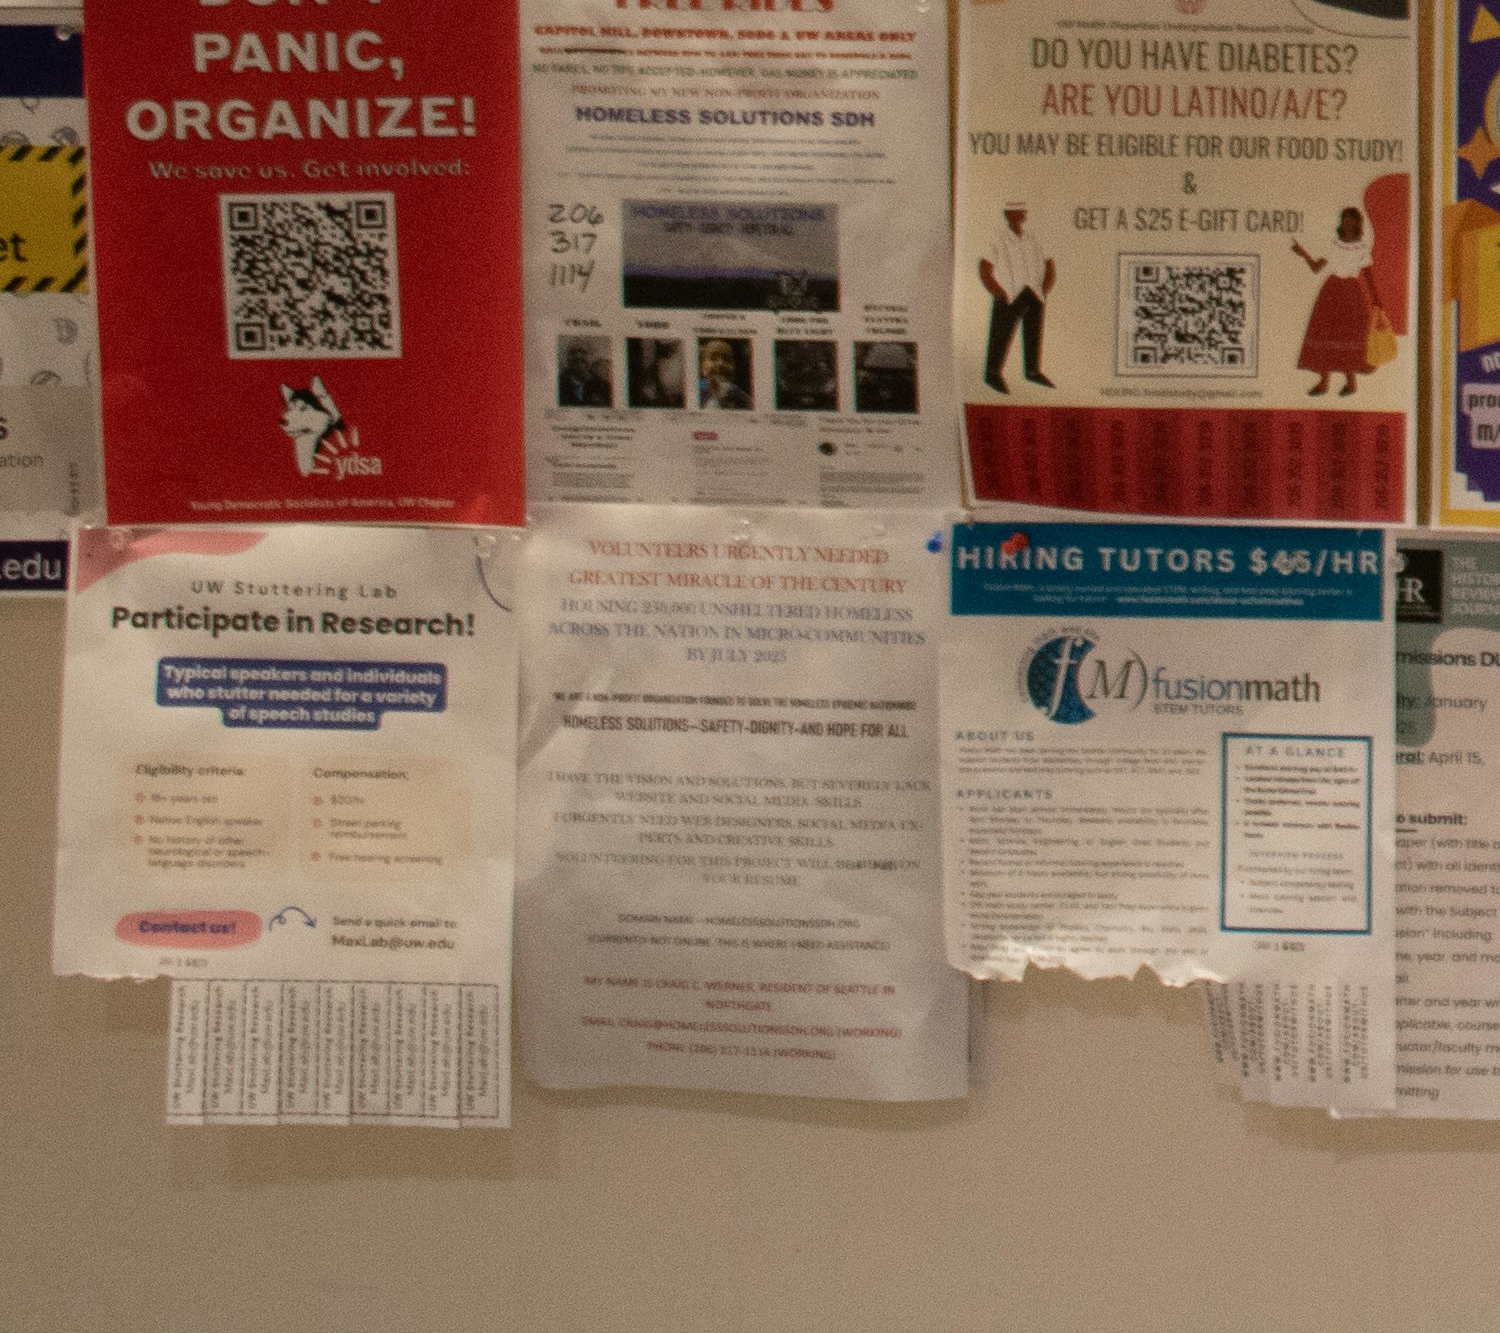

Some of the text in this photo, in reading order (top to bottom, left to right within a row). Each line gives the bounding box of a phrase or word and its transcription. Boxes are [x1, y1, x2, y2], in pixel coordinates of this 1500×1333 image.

[194, 31, 405, 79] PANIC,
[126, 99, 477, 142] ORGANIZE!
[551, 204, 605, 225] 206
[551, 232, 599, 255] 317
[111, 606, 476, 639] Participate in Research!
[1153, 668, 1321, 705] fusionmath
